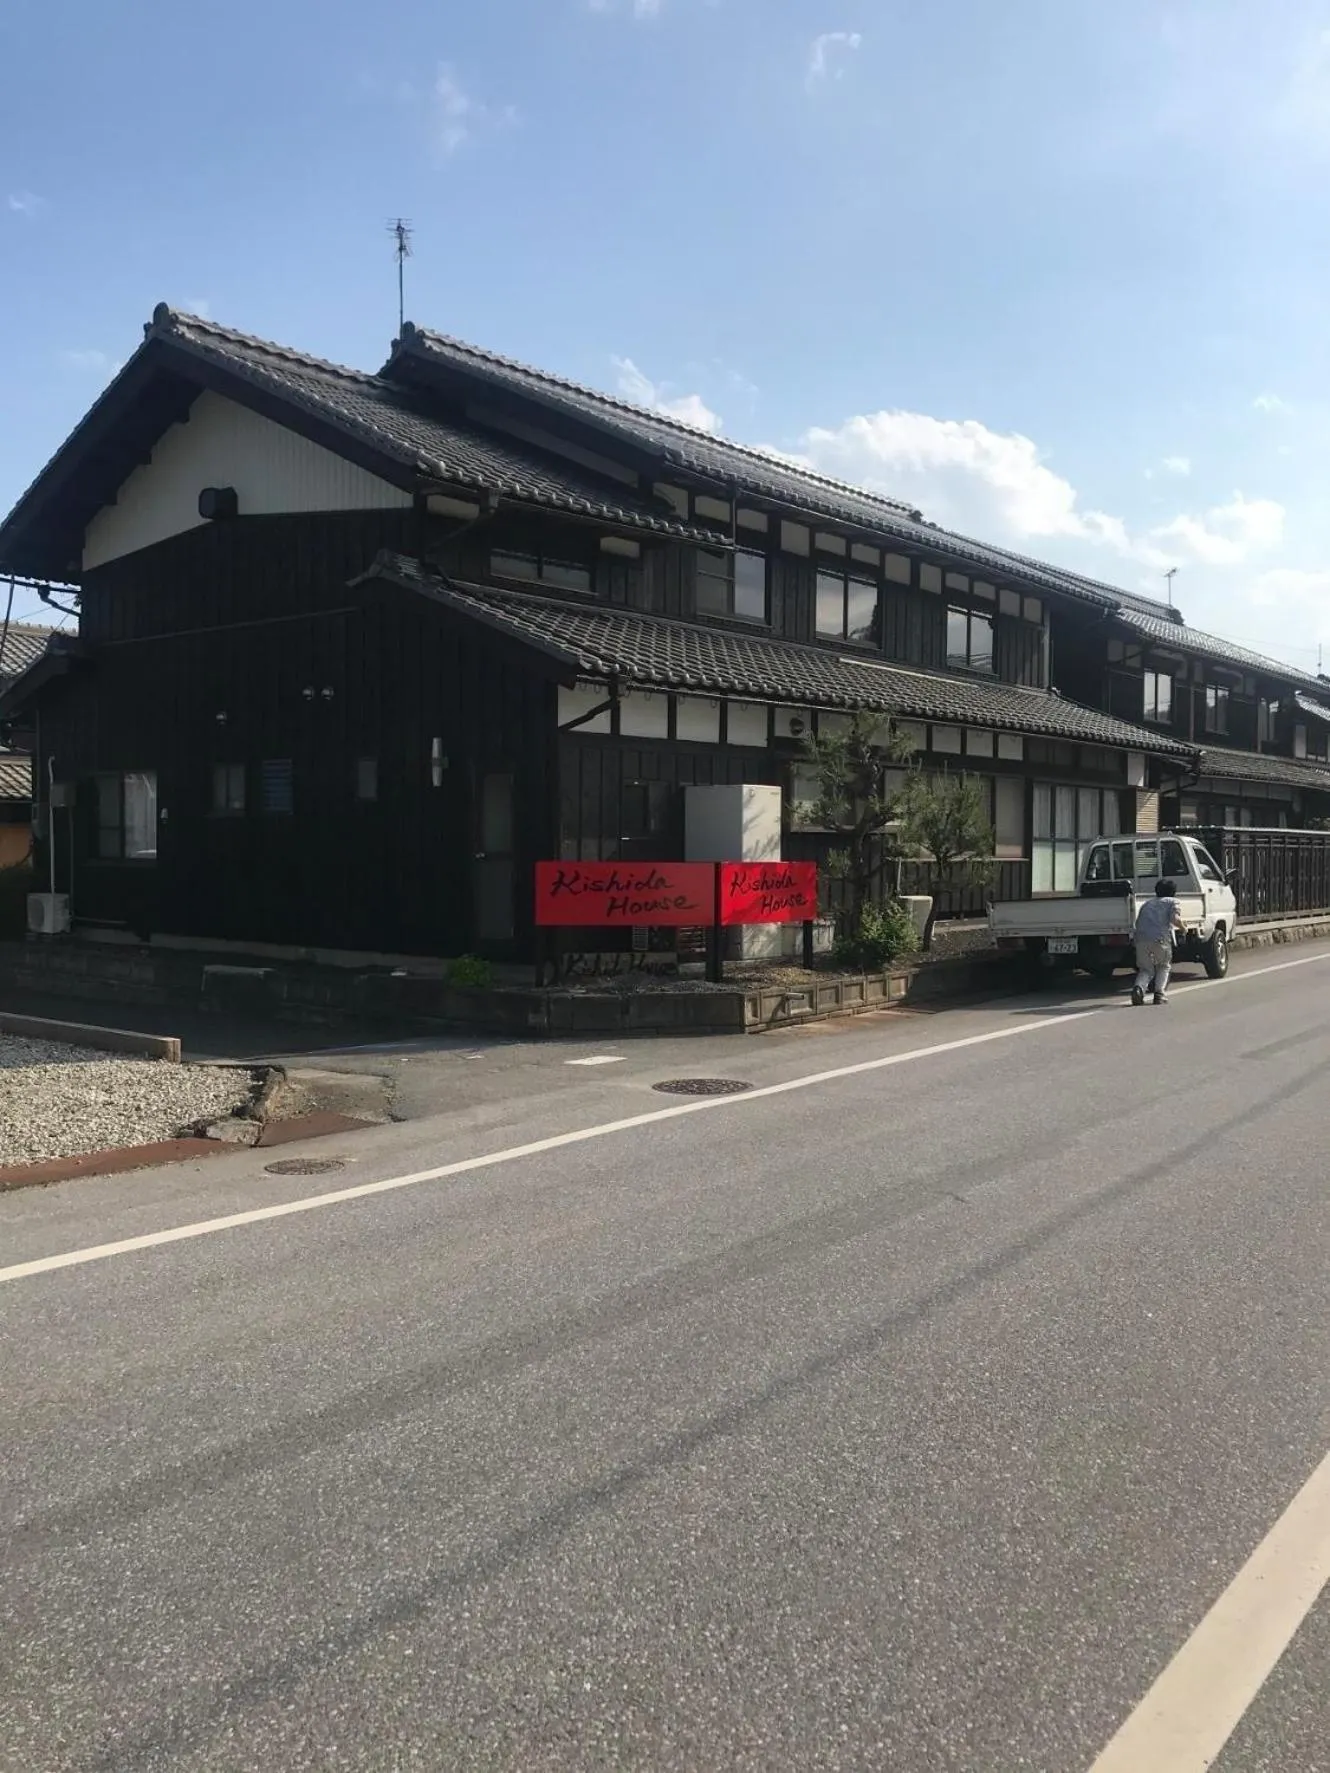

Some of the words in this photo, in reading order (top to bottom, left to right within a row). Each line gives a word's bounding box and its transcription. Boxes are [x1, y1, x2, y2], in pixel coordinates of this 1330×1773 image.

[550, 869, 674, 896] Kishida
[730, 869, 797, 897] Kishida
[606, 895, 699, 917] House
[760, 892, 808, 914] House
